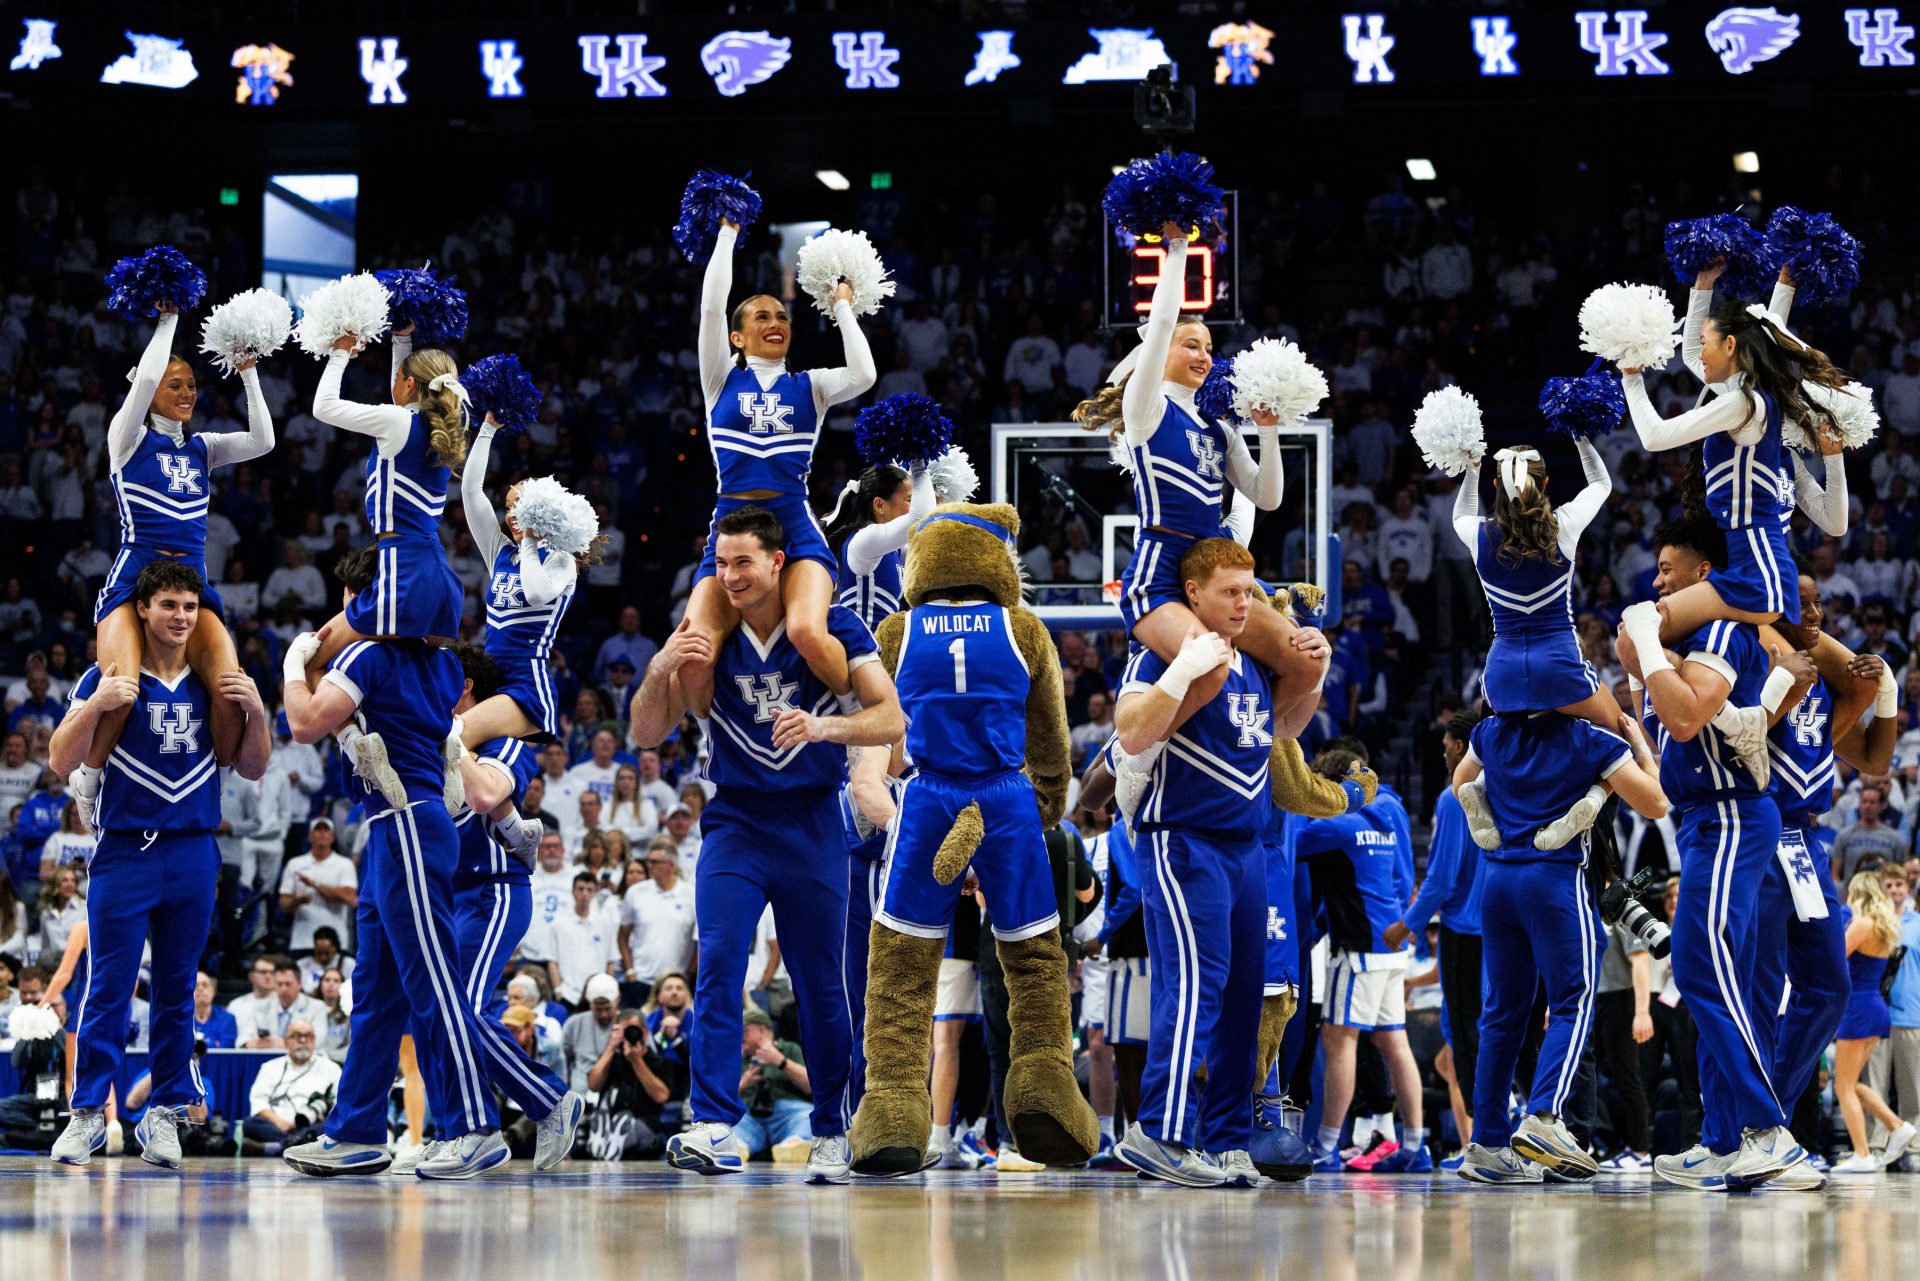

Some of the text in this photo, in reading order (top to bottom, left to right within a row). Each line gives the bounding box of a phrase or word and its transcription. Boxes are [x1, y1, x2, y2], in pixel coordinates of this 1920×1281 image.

[832, 32, 900, 89] UK
[1342, 15, 1395, 82] UK
[1470, 16, 1518, 75] UK
[1576, 11, 1669, 76] UK
[1845, 9, 1915, 66] UK
[358, 37, 408, 104] UK
[480, 40, 524, 96] UK
[578, 34, 668, 98] UK
[738, 392, 794, 433] UK
[155, 452, 203, 495] UK
[1185, 429, 1224, 479] UK
[491, 571, 524, 609] UK
[922, 615, 992, 634] WILDCAT
[948, 638, 967, 694] 1
[735, 672, 800, 724] UK
[1227, 693, 1274, 747] UK
[1787, 696, 1828, 747] UK
[147, 702, 203, 754] UK
[1786, 849, 1815, 885] UK
